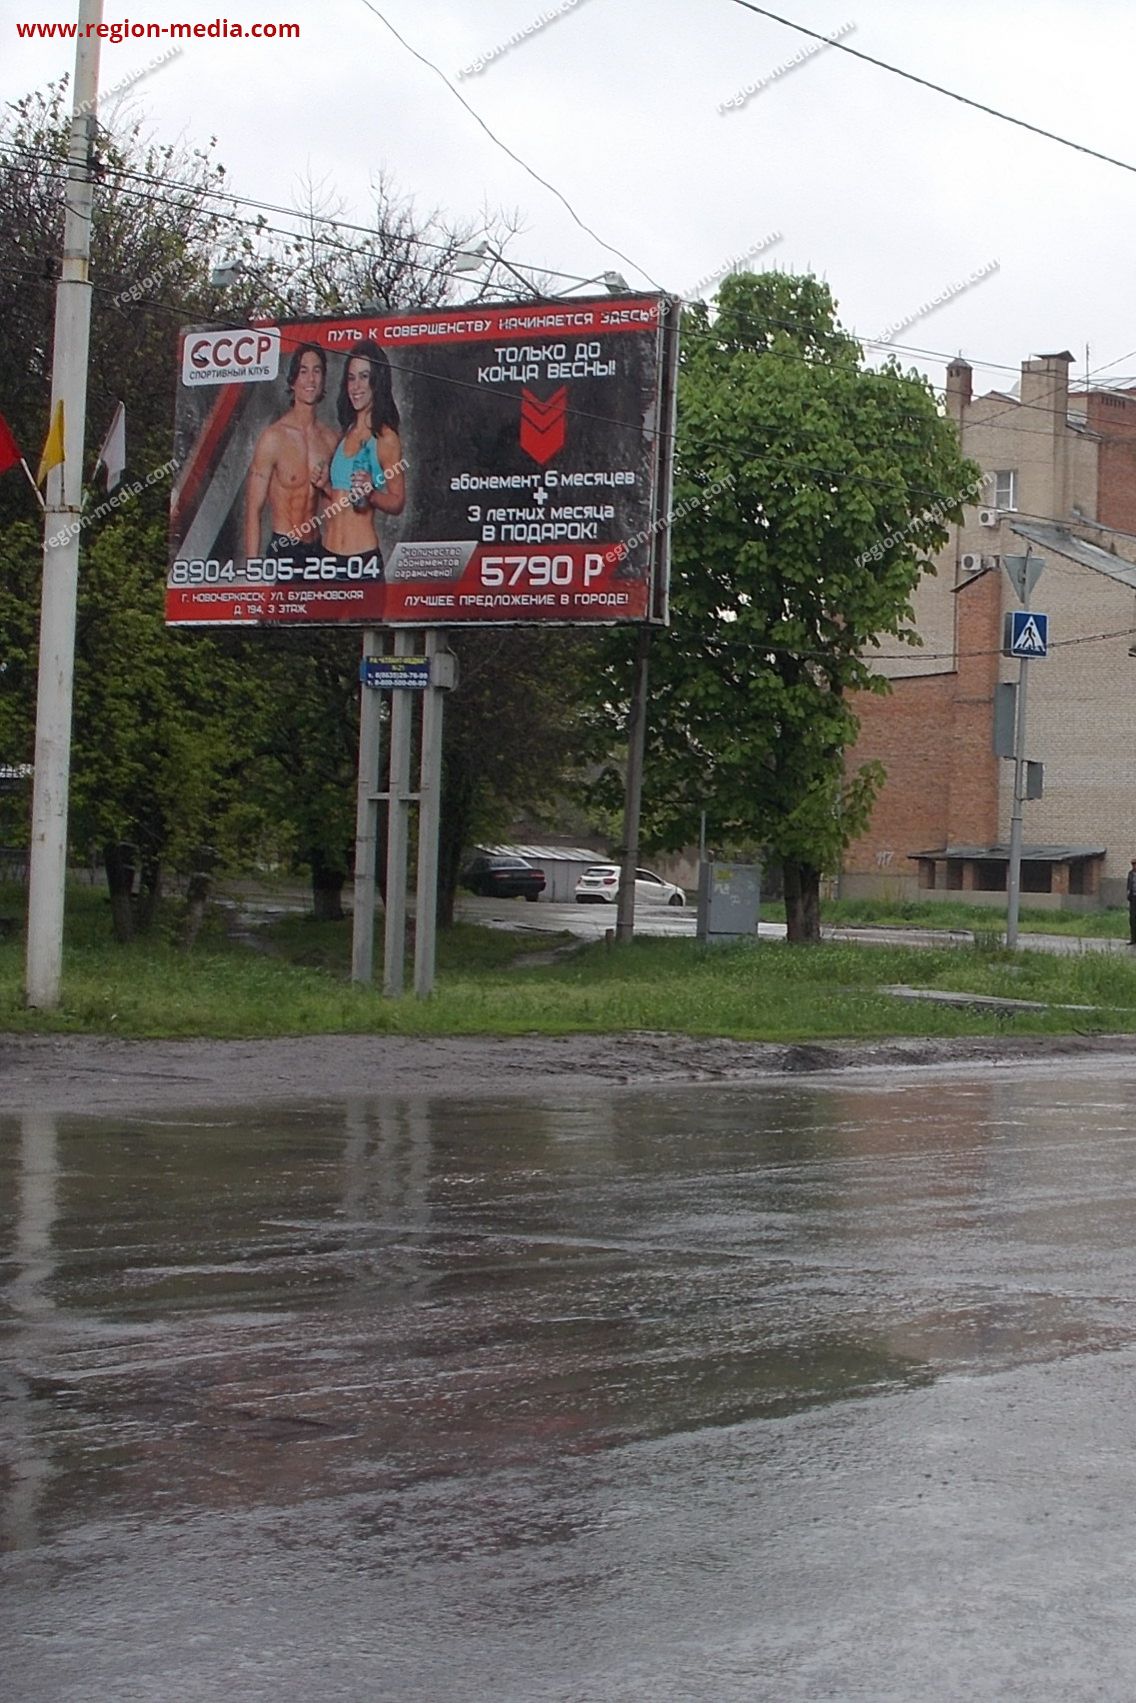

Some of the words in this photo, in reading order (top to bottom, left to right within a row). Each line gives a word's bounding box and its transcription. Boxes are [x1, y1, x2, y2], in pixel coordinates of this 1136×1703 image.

[328, 329, 363, 342] ПУТЬ
[369, 327, 379, 339] К
[383, 320, 492, 338] СОВЕРШЕНСТВУ
[498, 313, 593, 330] НАЧИНАЕТСЯ
[190, 336, 272, 368] СССР
[494, 343, 566, 363] ТОЛЬКО
[575, 342, 601, 361] ДО
[189, 368, 247, 380] СПОРТИВНЫЙ
[248, 366, 270, 377] КЛУБ
[478, 364, 539, 383] КОНЦА
[547, 360, 616, 379] ВЕСНЫ!
[450, 473, 541, 490] абонемент
[544, 470, 558, 487] 6
[560, 471, 635, 488] месяцев
[467, 505, 481, 522] 3
[486, 506, 545, 522] летних
[550, 505, 615, 521] месяца
[482, 525, 496, 541] В
[500, 523, 598, 543] ПОДАРОК!
[172, 556, 380, 584] 8904-505-26-04
[398, 559, 460, 567] абонементов
[480, 555, 573, 587] 5790
[584, 553, 603, 587] Р
[287, 590, 364, 602] БУДЕННОВСКАЯ
[404, 595, 454, 606] ЛУЧШЕЕ
[459, 594, 555, 608] ПРЕДЛОЖЕНИЕ
[560, 594, 569, 605] В
[574, 593, 629, 606] ГОРОДЕ!
[267, 604, 275, 614] 3
